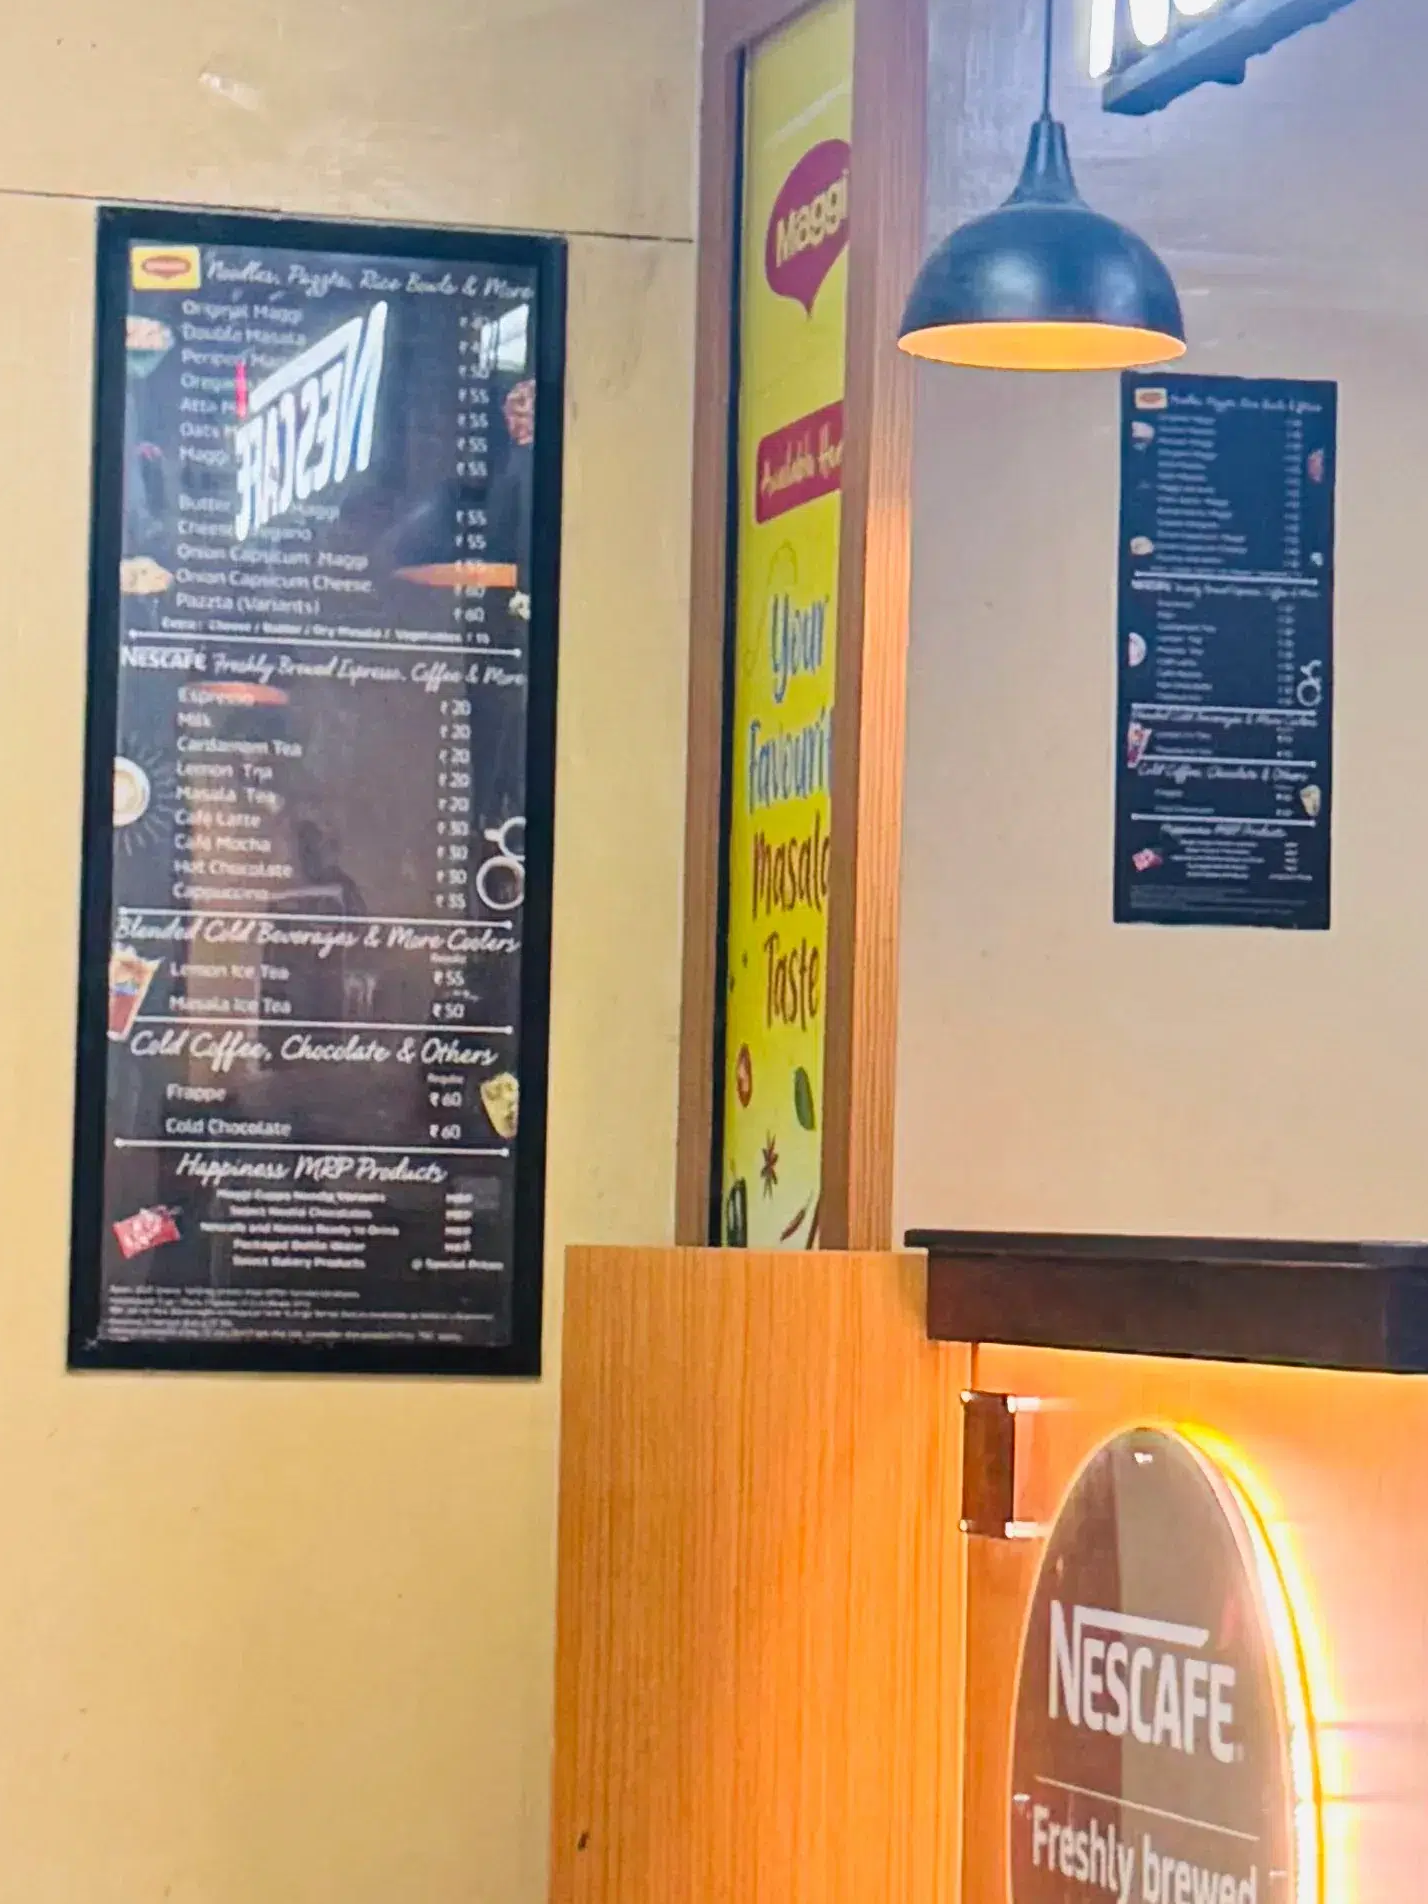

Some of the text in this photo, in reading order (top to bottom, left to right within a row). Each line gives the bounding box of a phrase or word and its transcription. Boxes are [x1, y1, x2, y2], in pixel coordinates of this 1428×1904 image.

[775, 168, 849, 267] Maggi
[771, 594, 829, 704] Your
[763, 929, 821, 1031] Taste
[129, 1030, 184, 1057] Cold
[280, 1033, 391, 1063] Chocolate
[420, 1038, 498, 1066] Others
[165, 1117, 205, 1134] Cold
[207, 1117, 292, 1138] Chocolate
[175, 1152, 290, 1187] Happiness
[355, 1154, 448, 1184] Products
